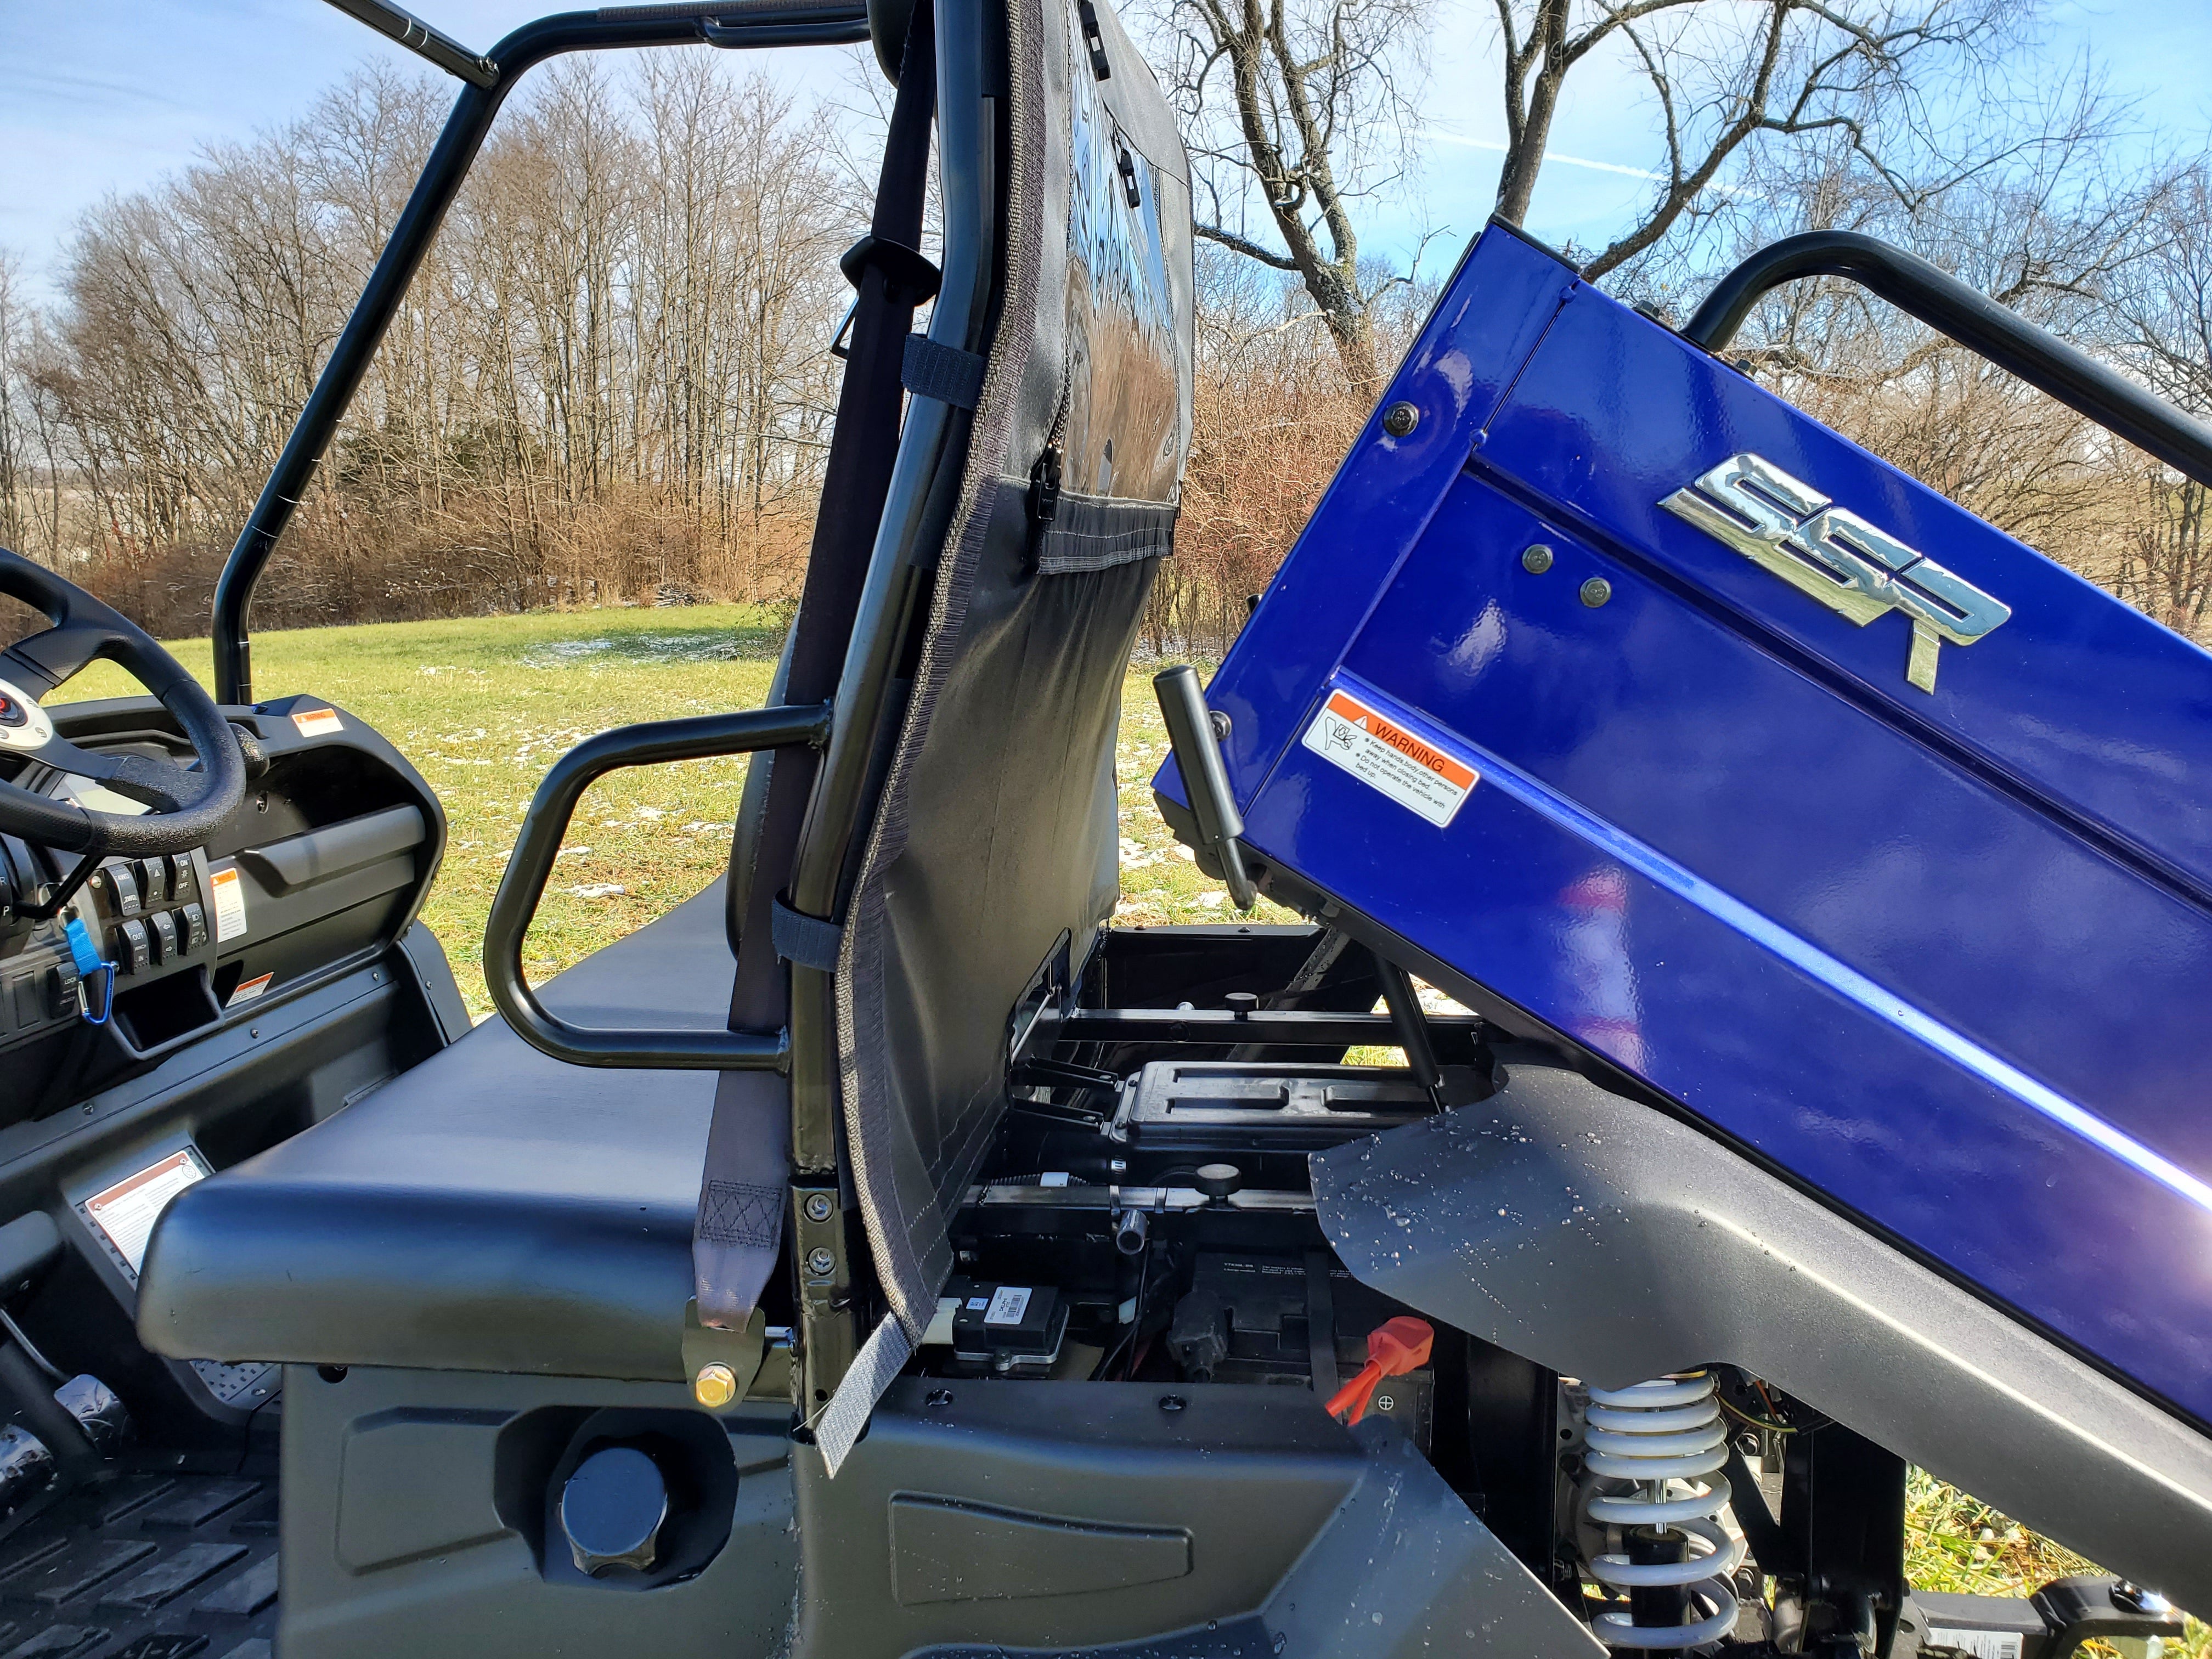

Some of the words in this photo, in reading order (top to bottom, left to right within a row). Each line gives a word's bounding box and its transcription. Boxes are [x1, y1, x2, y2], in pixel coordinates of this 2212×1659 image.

[1375, 723, 1445, 773] WARNING
[1355, 762, 1368, 773] bed
[1367, 770, 1376, 779] up.
[1365, 749, 1381, 761] away
[1381, 758, 1397, 770] when
[1397, 768, 1418, 783] closing
[1418, 779, 1431, 790] bed.
[1369, 740, 1386, 753] Keep
[1434, 780, 1458, 796] persons
[1360, 755, 1370, 764] Do
[1369, 761, 1381, 770] not
[1379, 768, 1402, 783] operate
[1401, 780, 1412, 789] the
[1412, 787, 1432, 802] vehicle
[1432, 799, 1446, 809] with
[117, 872, 130, 881] 4WD
[178, 881, 189, 889] OFF
[123, 894, 137, 903] 2WD
[3, 905, 10, 917] P
[132, 932, 144, 941] OUT
